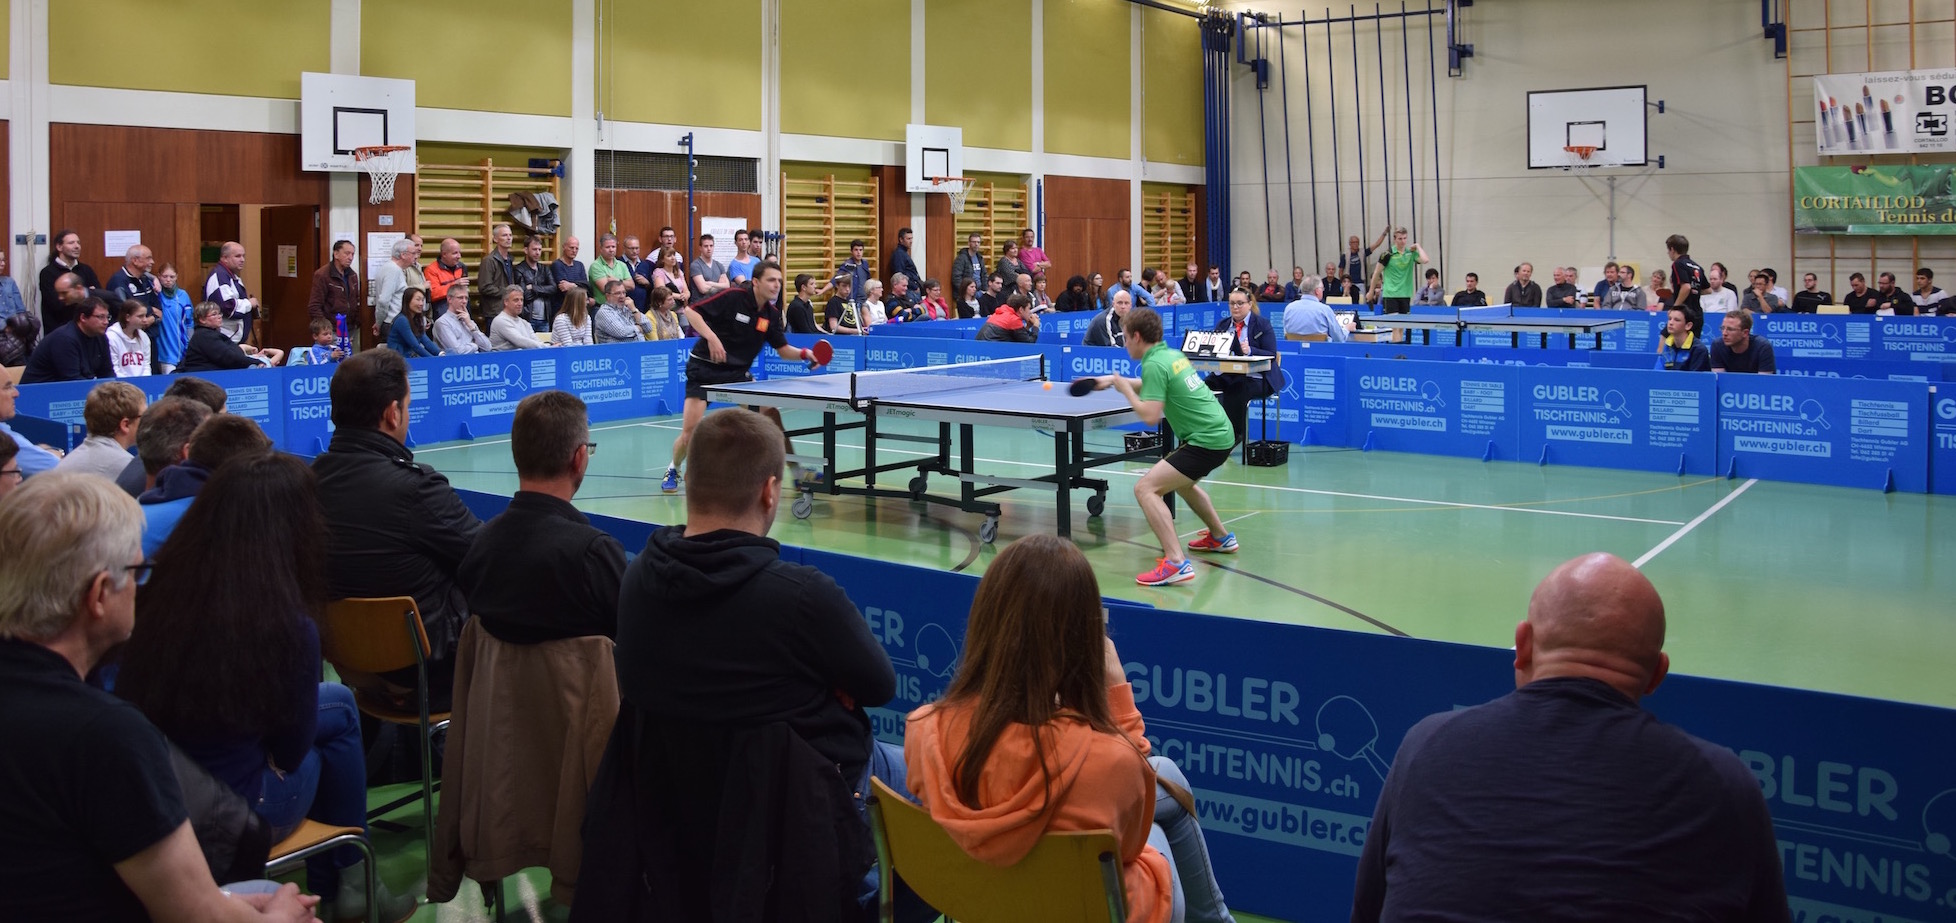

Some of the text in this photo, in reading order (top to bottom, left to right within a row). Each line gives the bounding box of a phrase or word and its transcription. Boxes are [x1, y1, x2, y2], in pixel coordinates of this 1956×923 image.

[1865, 74, 1926, 84] laissez-vous
[1801, 195, 1926, 209] CORTAILLOD
[1877, 209, 1936, 223] Tennis
[1074, 319, 1092, 330] GUB
[1767, 321, 1818, 332] GUBLER
[1883, 323, 1938, 336] GUBLER
[1187, 335, 1230, 352] 6 2 0 7
[1883, 342, 1945, 352] TISCHTENNIS
[121, 351, 144, 367] GAP
[867, 350, 899, 362] UBLER
[571, 358, 612, 373] GUBLER
[1071, 357, 1131, 375] GUBLER
[442, 364, 500, 384] GUBLER
[290, 377, 332, 396] GUB
[571, 378, 625, 390] TISCHTENNIS.ch
[1360, 375, 1417, 392] GUBLER
[442, 389, 507, 406] TISCHTENNIS
[582, 389, 630, 401] www.gubler.ch
[1533, 384, 1599, 402] GUBLER
[825, 402, 853, 412] JETmag
[1360, 398, 1436, 413] TISCHTENNIS.ch
[1720, 392, 1794, 411] GUBLER
[1858, 401, 1894, 409] Tischtennis
[291, 406, 333, 421] TISCHT
[886, 408, 916, 417] JETmagic
[1533, 408, 1620, 424] TISCHTENNIS.ch
[1858, 410, 1900, 418] Tischfussball
[1375, 416, 1443, 428] www.gubler.ch
[1720, 418, 1817, 436] TISCHTENNIS.ch
[1551, 429, 1629, 440] www.gubler.ch
[1739, 438, 1827, 453] www.gubler.ch
[1123, 661, 1300, 726] GUBLER
[1149, 735, 1360, 799] SCHTENNIS.ch
[1740, 749, 1898, 821] BLER
